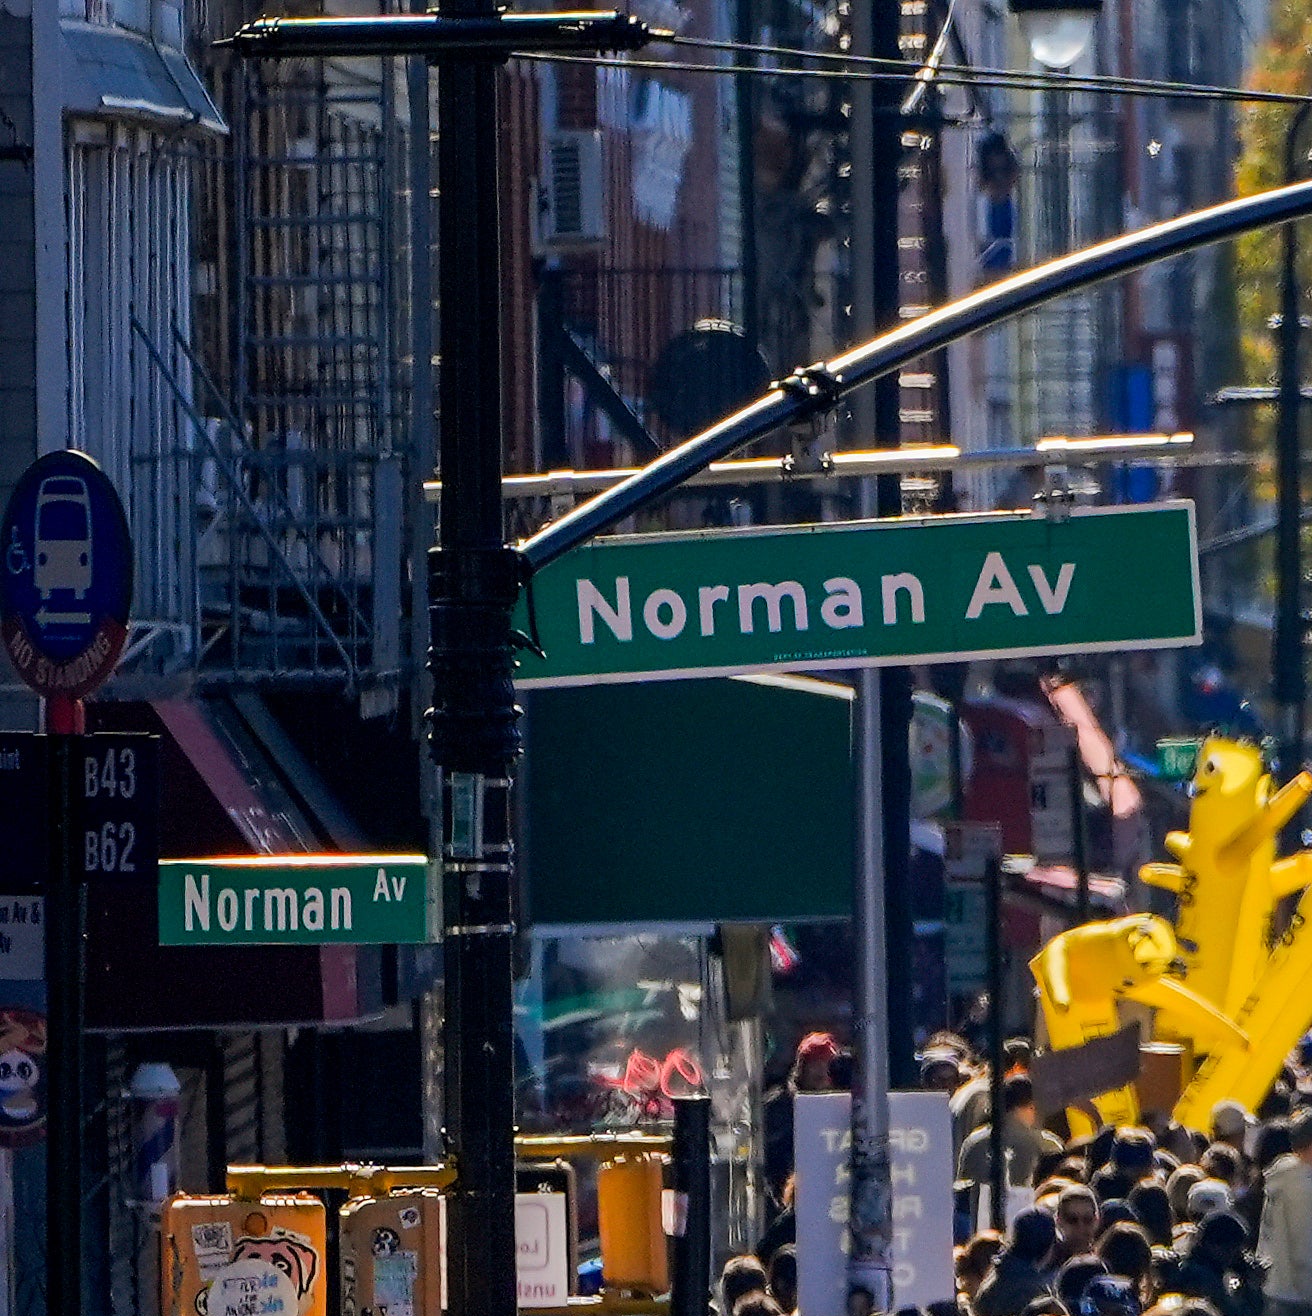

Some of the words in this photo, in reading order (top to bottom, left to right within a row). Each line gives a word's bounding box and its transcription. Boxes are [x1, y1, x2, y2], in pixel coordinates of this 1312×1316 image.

[576, 570, 926, 645] Norman
[964, 551, 1076, 620] Av
[84, 748, 137, 799] B43
[84, 821, 137, 872] B62
[184, 874, 352, 931] Norman
[372, 868, 407, 902] Av
